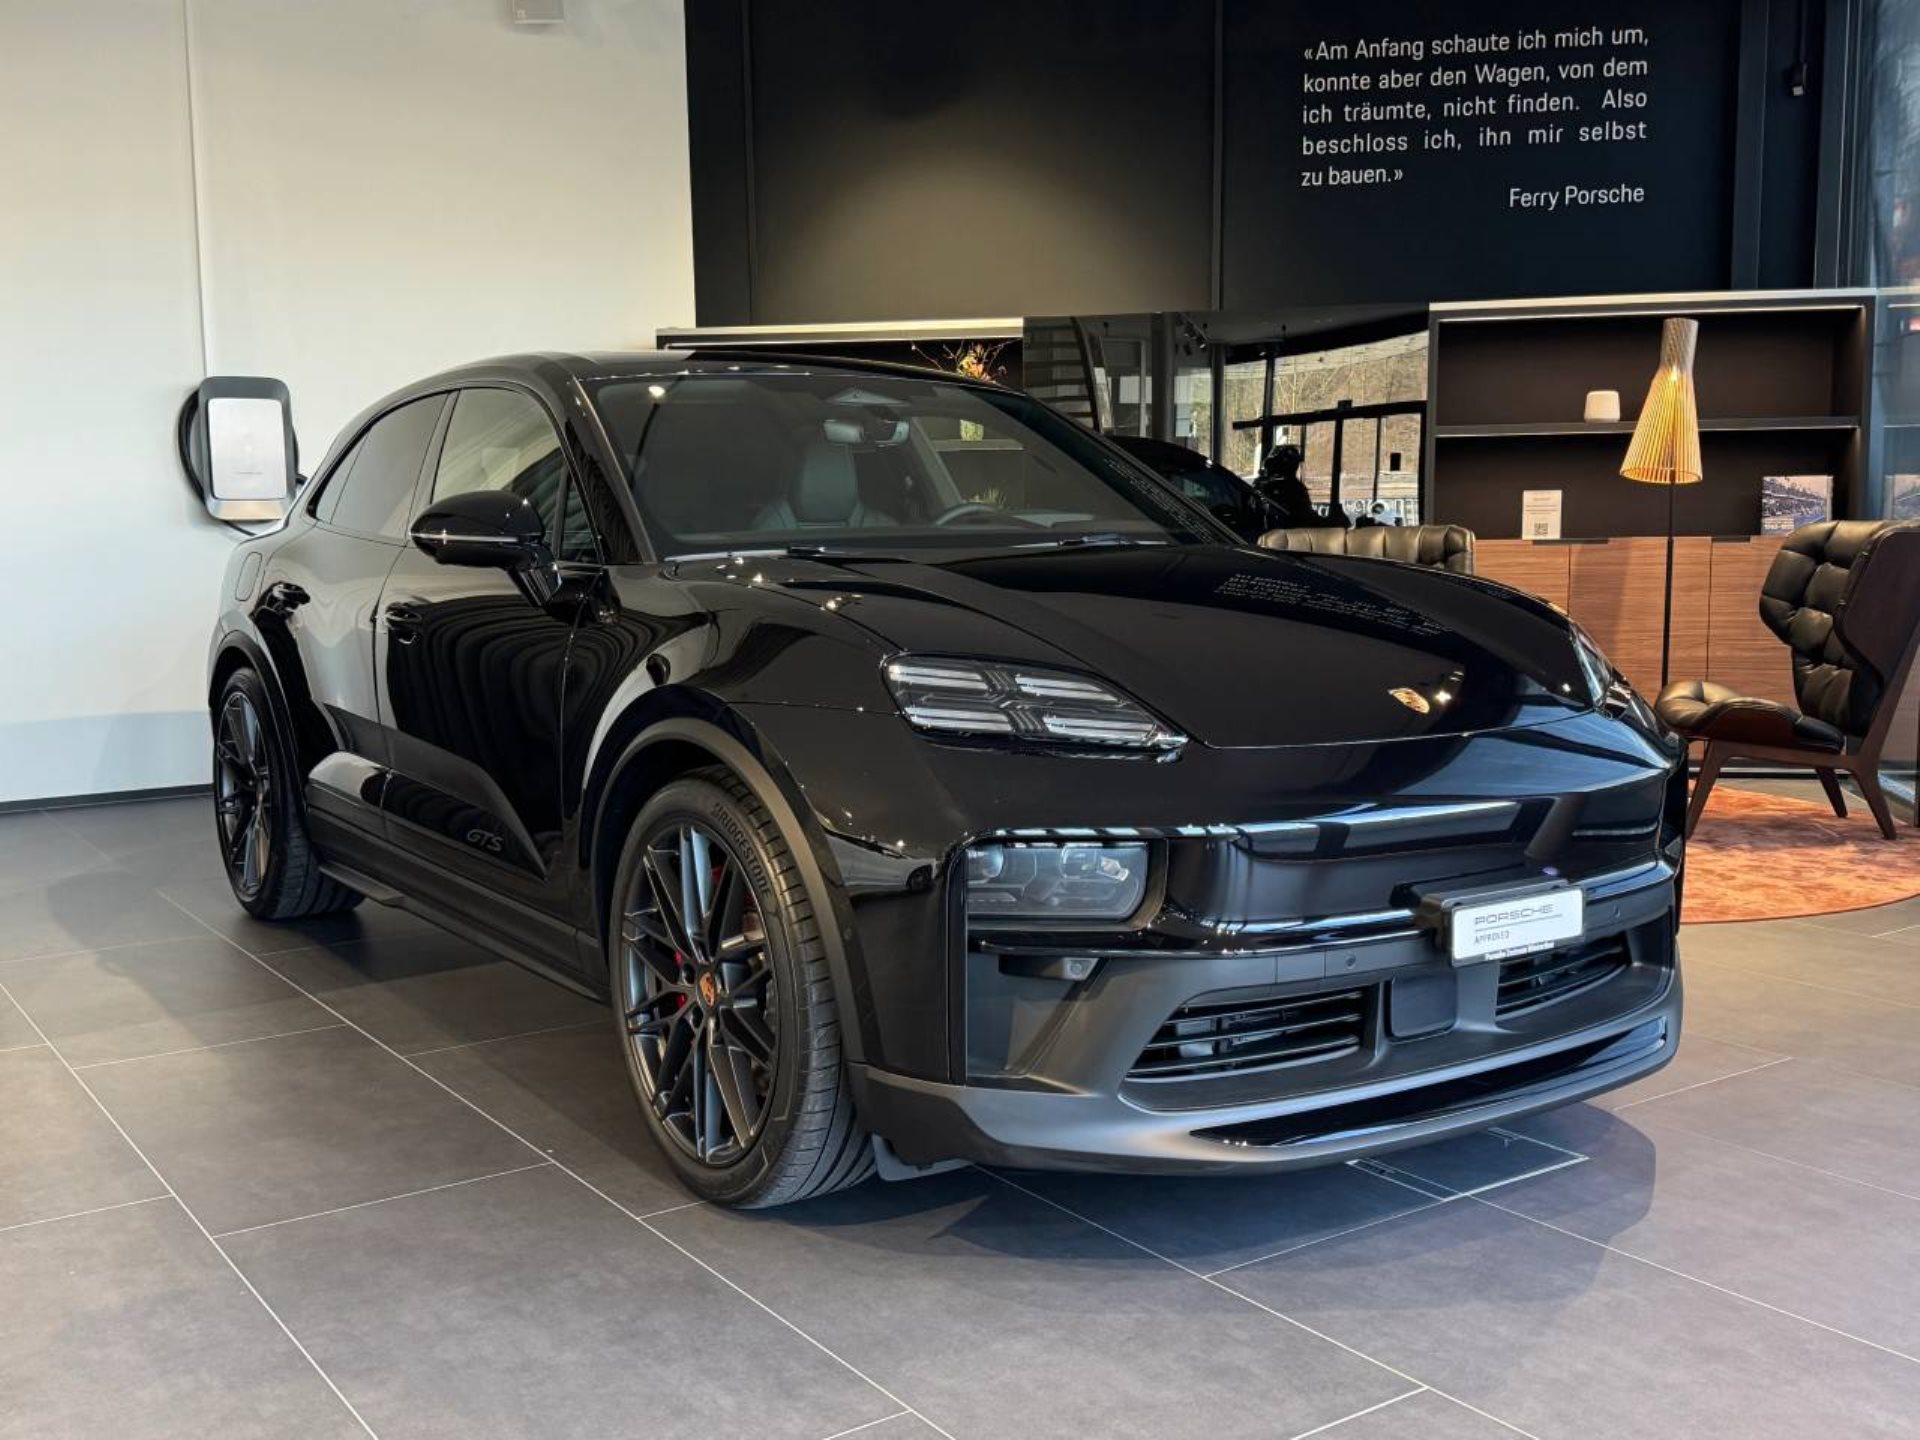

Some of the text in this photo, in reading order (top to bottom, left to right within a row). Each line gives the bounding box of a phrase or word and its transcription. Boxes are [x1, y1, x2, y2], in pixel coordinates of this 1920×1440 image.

[1305, 27, 1648, 60] «Am Anfang schaute ich mich um,
[1304, 57, 1647, 92] konnte aber den Wagen, von dem
[1303, 89, 1647, 124] ich träumte, nicht finden. Also
[1303, 121, 1646, 155] beschloss ich, ihn mir selbst
[1302, 166, 1403, 186] zu bauen.»
[1510, 184, 1644, 210] Ferry Porsche
[467, 829, 504, 852] GTS
[1474, 904, 1554, 925] PORSCHE
